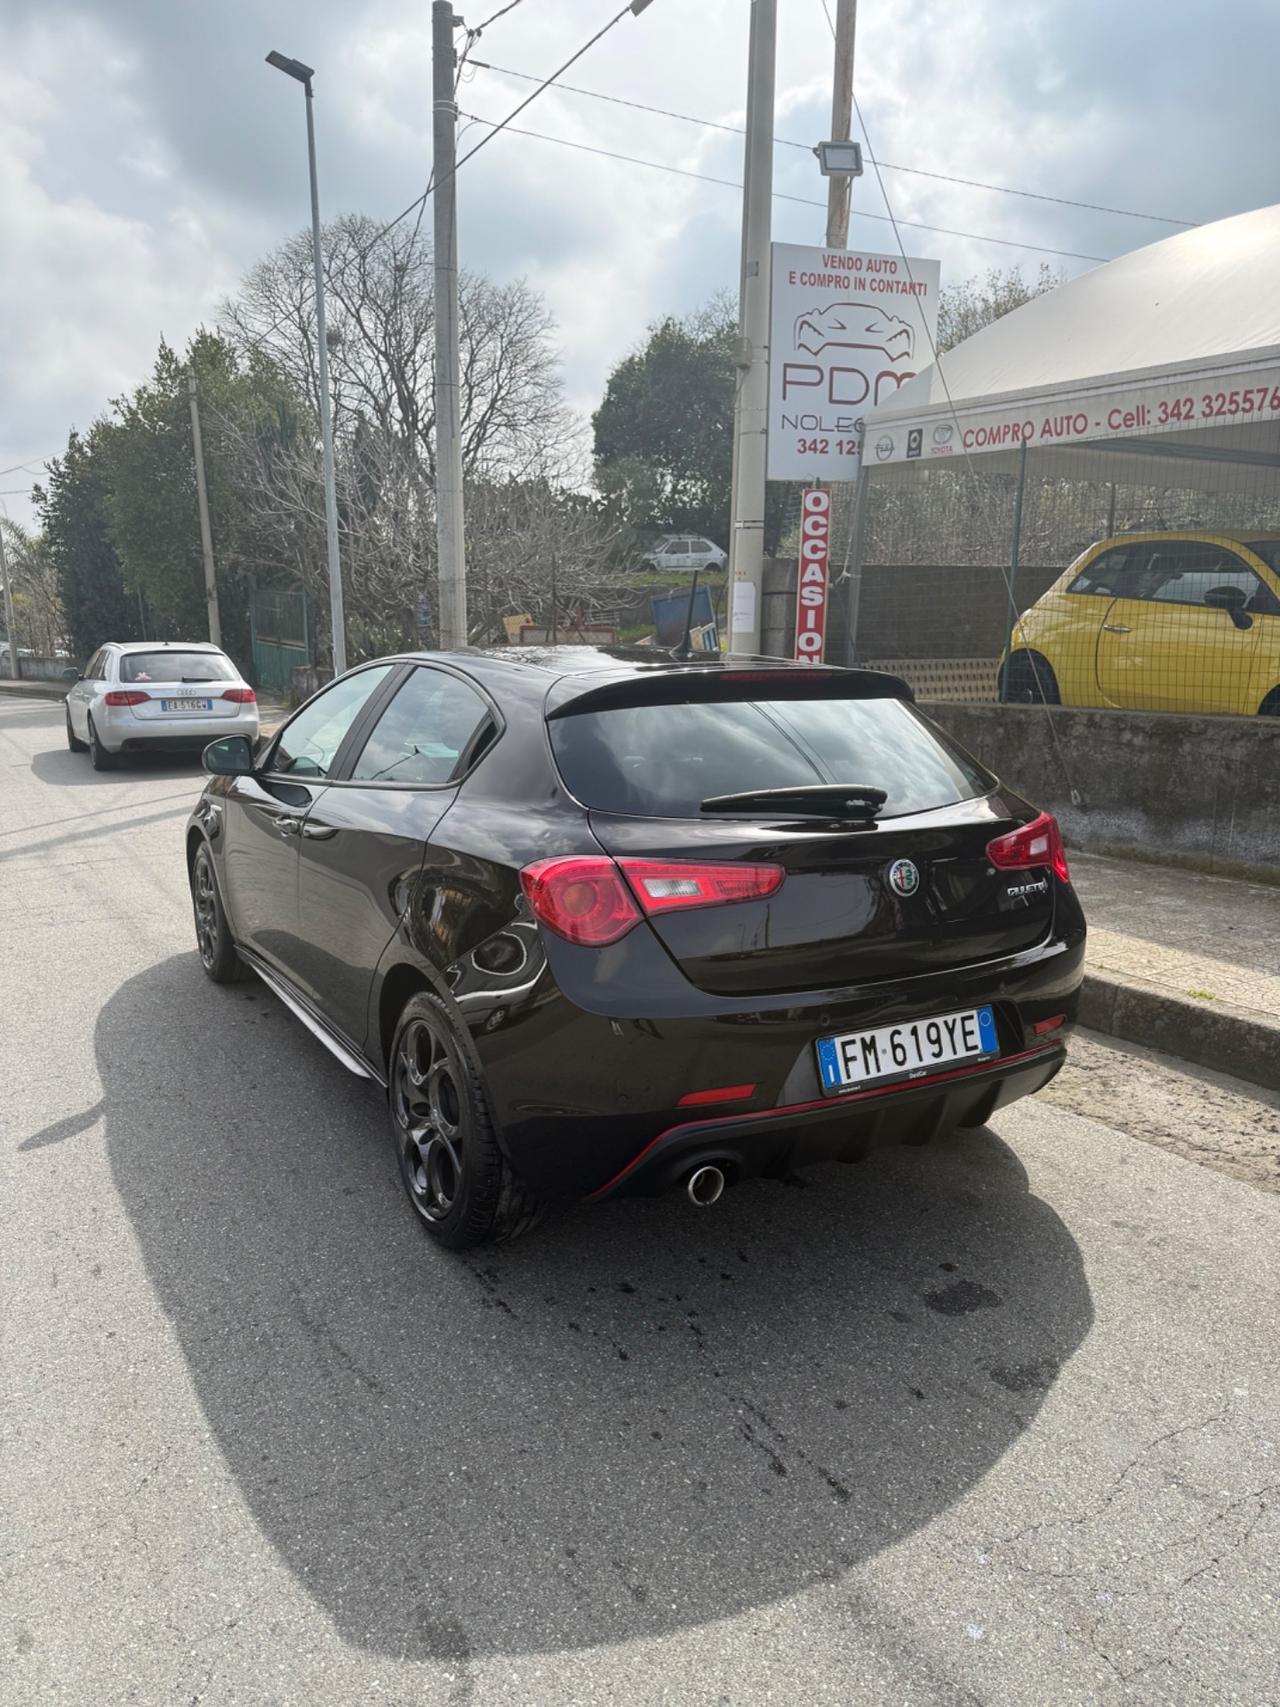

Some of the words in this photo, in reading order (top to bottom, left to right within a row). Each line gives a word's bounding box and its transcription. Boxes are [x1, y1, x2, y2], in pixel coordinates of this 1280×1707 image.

[822, 254, 863, 271] VENDO
[866, 259, 897, 274] AUTO
[789, 271, 797, 285] E
[800, 272, 850, 289] COMPRO
[854, 277, 866, 291] IN
[870, 279, 927, 296] CONTANTI
[963, 420, 1034, 448] COMPRO
[1040, 413, 1088, 438] AUTO
[1108, 404, 1151, 430] Cell:
[1158, 398, 1195, 424] 342
[797, 438, 829, 455] 342
[836, 440, 861, 455] 12
